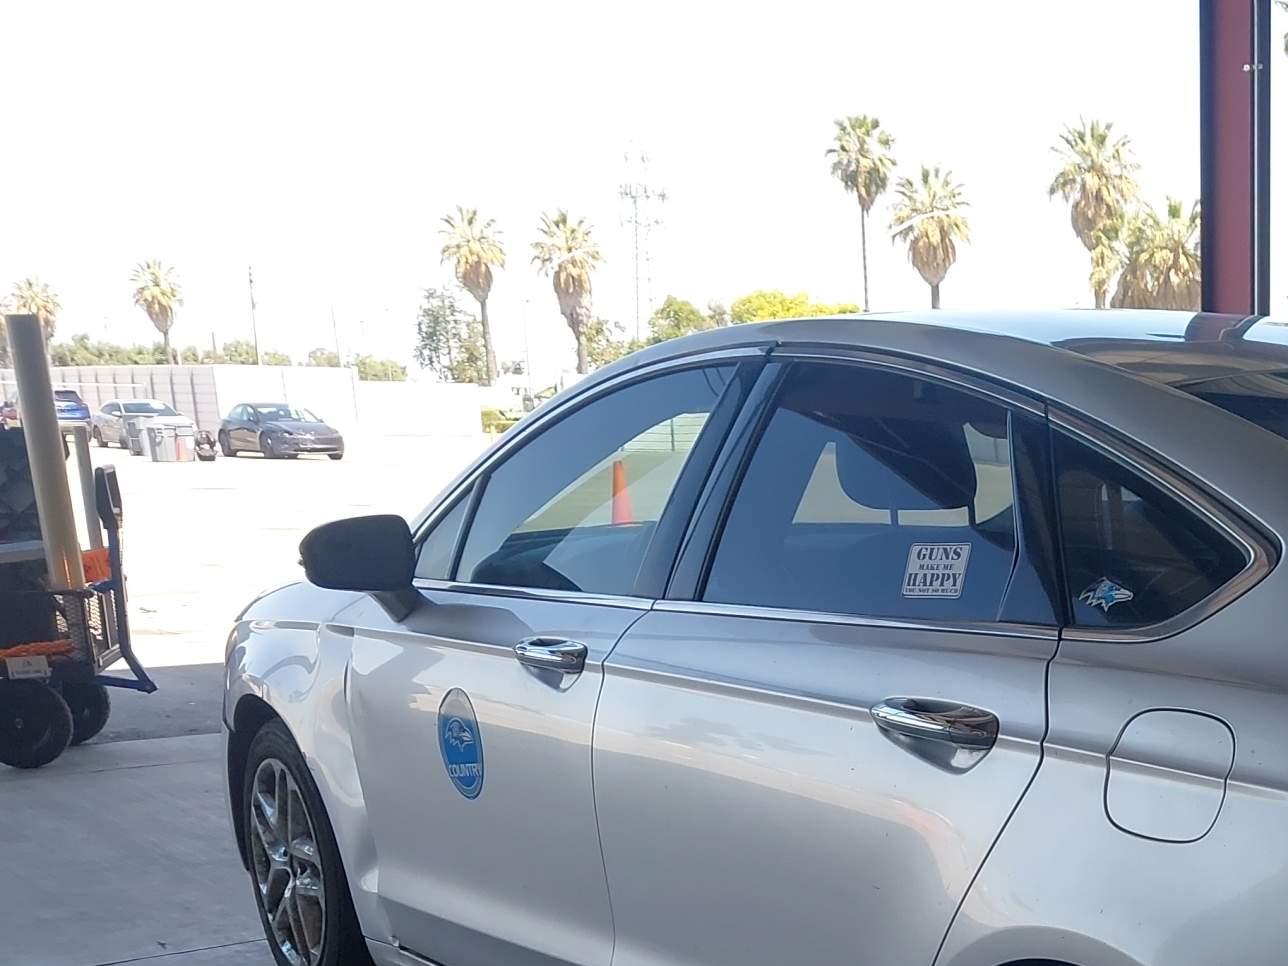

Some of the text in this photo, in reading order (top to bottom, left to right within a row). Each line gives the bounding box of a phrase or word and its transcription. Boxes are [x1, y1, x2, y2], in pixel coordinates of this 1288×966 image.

[916, 547, 962, 561] GUNS
[919, 563, 955, 571] MAKE ME
[906, 572, 962, 587] HAPPY
